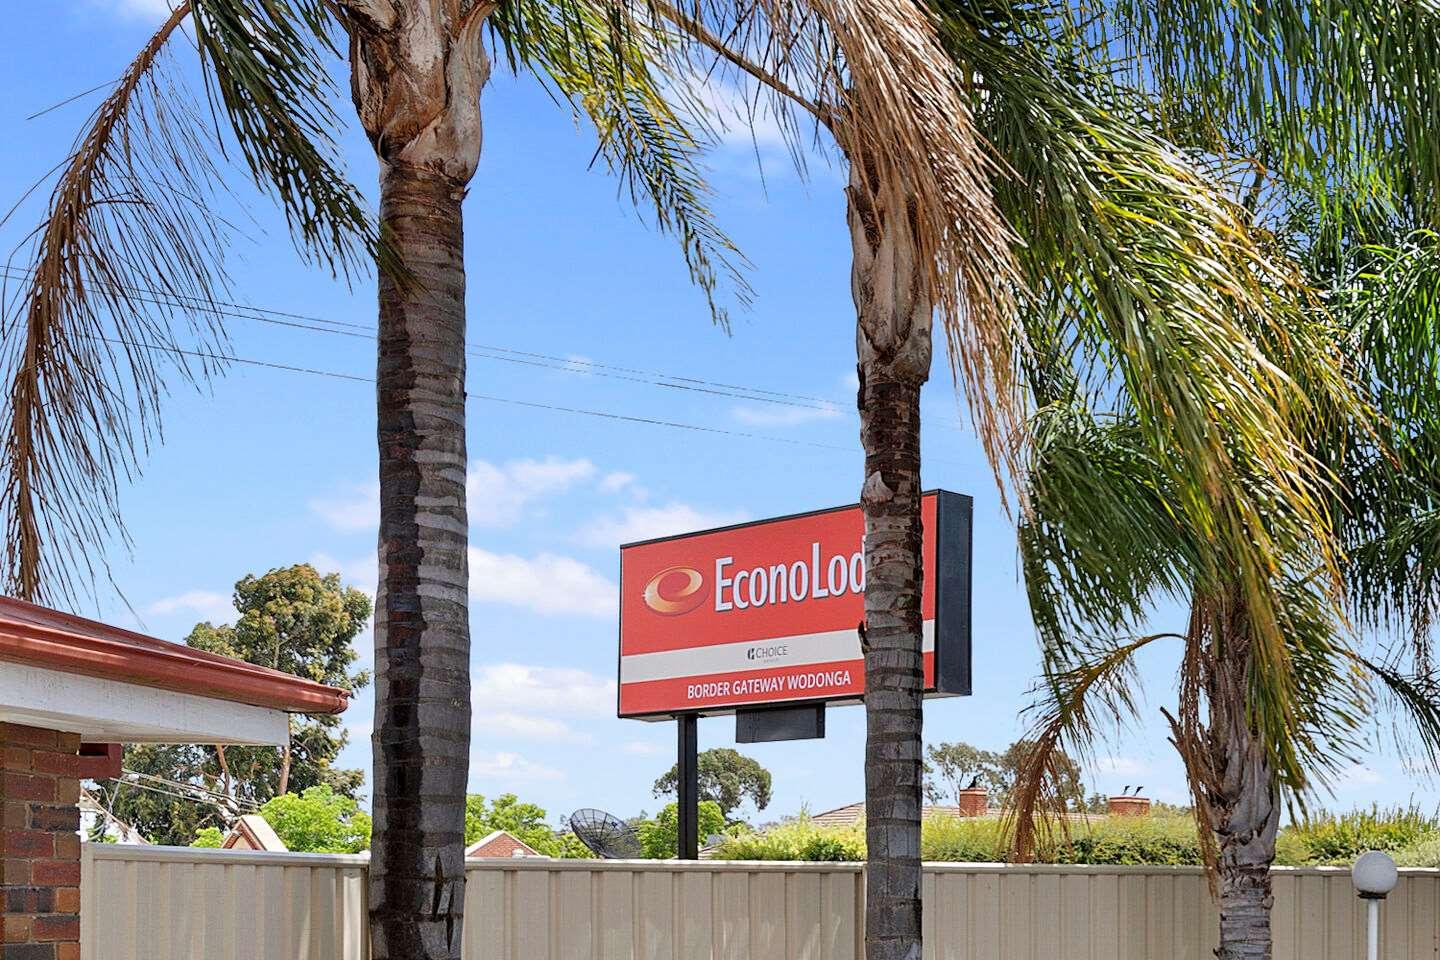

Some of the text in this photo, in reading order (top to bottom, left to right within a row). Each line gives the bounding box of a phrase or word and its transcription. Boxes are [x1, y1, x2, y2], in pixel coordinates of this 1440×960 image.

[715, 535, 866, 612] EconoLod
[756, 646, 788, 658] CHOICE
[687, 670, 851, 699] BORDER GATEWAY WODONGA
